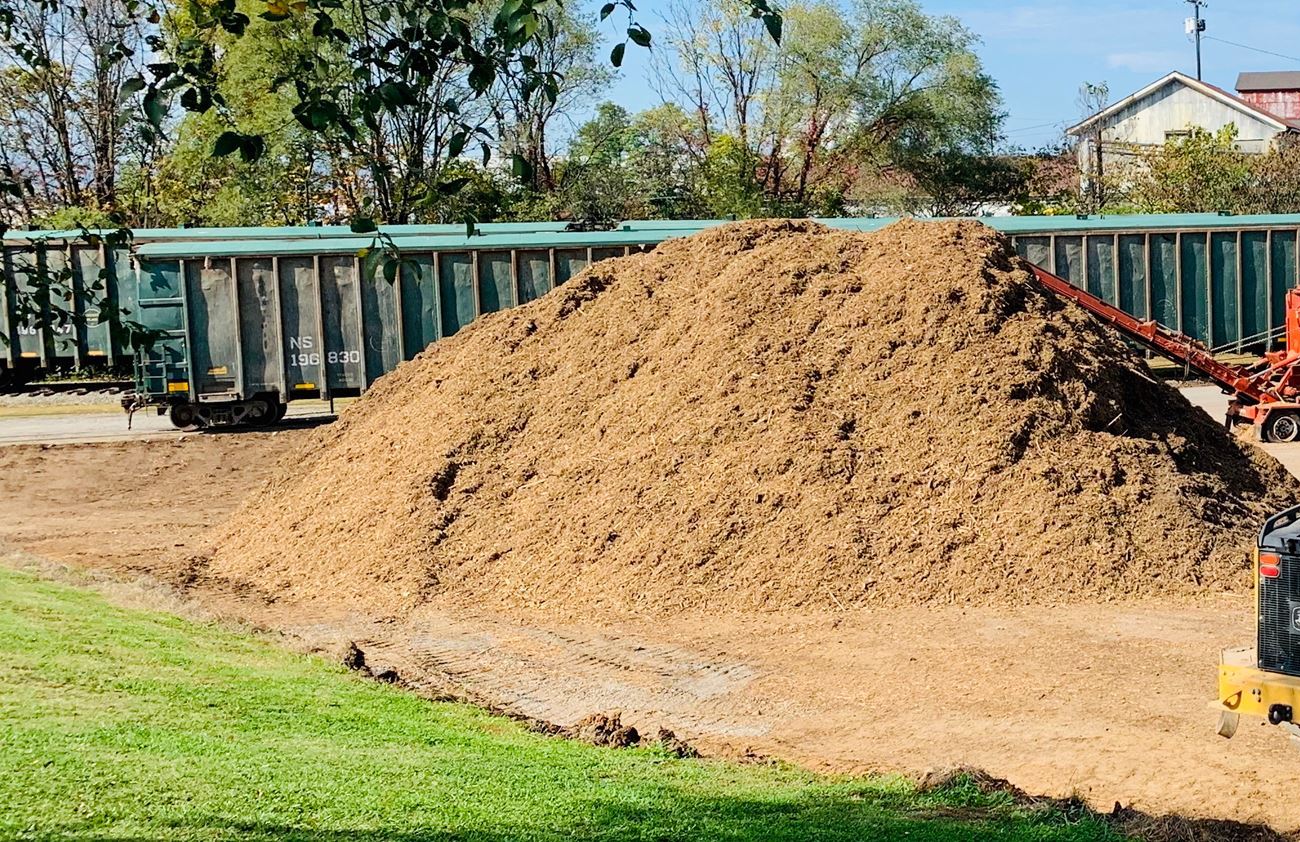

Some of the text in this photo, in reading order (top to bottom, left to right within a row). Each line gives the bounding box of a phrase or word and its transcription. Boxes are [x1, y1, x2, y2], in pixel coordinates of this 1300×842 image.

[290, 336, 313, 349] NS
[291, 351, 360, 366] 196 830
